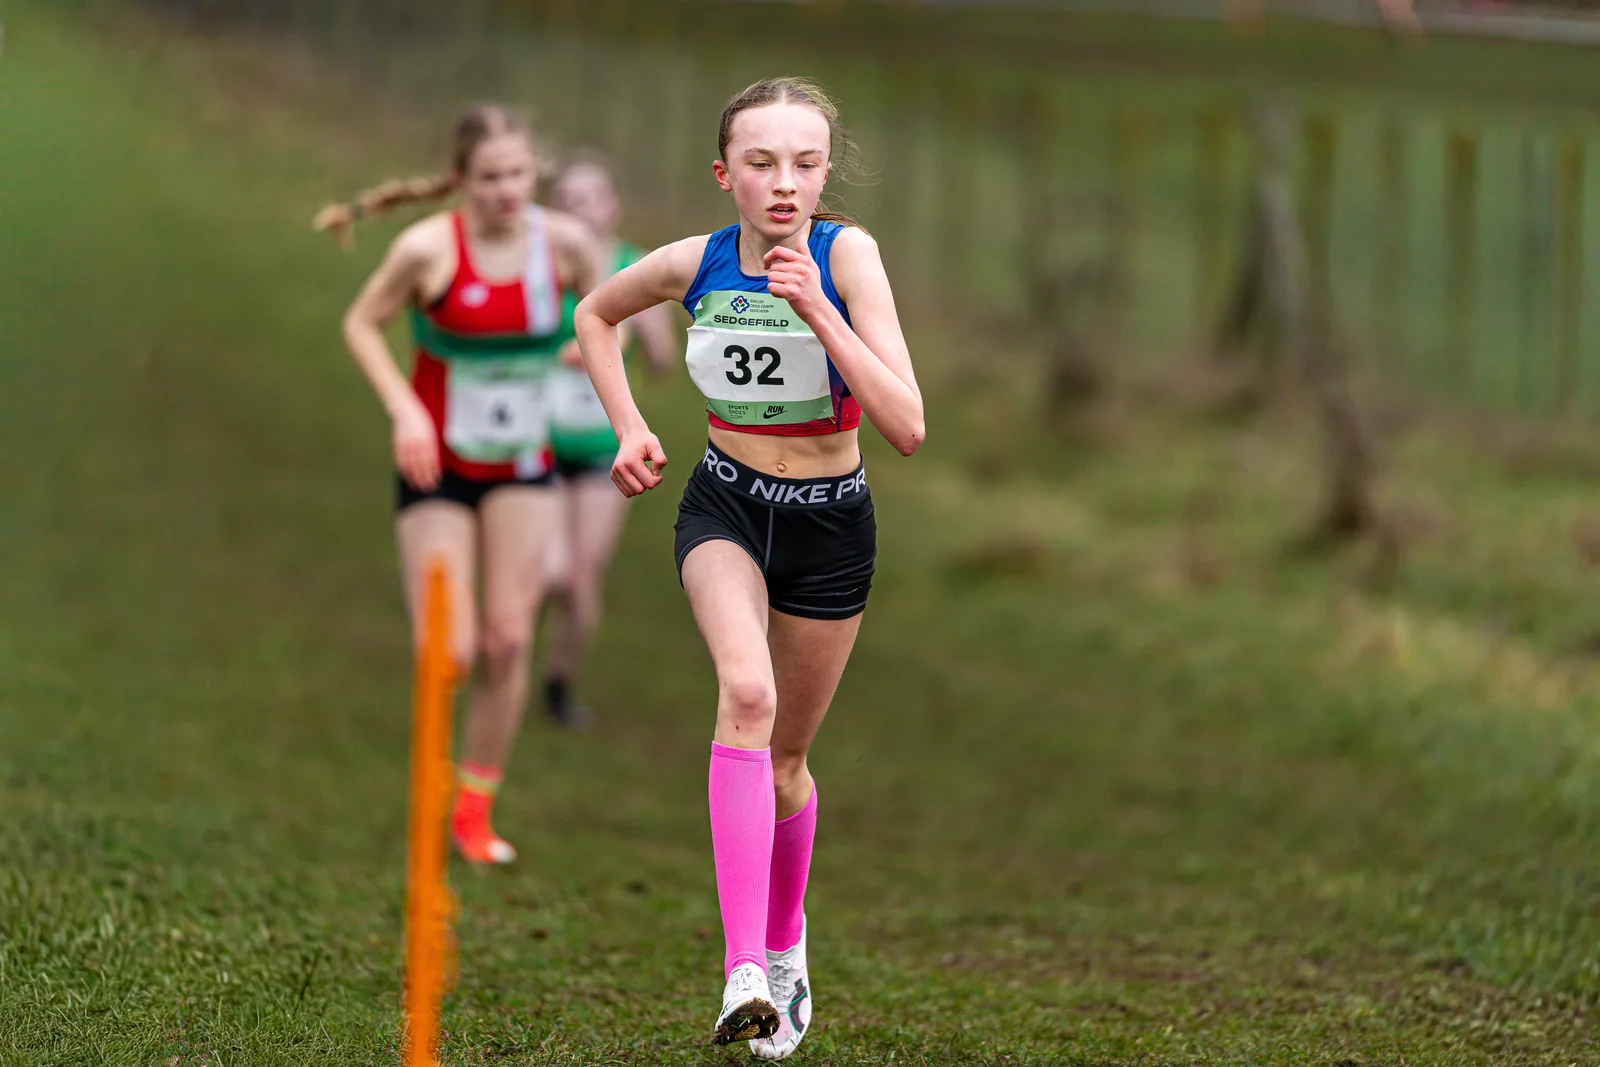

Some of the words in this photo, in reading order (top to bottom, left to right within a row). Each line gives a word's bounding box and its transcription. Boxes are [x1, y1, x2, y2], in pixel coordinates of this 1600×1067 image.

[714, 314, 789, 327] SEDGEFIELD
[723, 344, 785, 386] 32
[767, 405, 785, 413] RUN
[703, 446, 738, 482] RO
[750, 478, 831, 504] NIKE
[836, 467, 866, 500] PR
